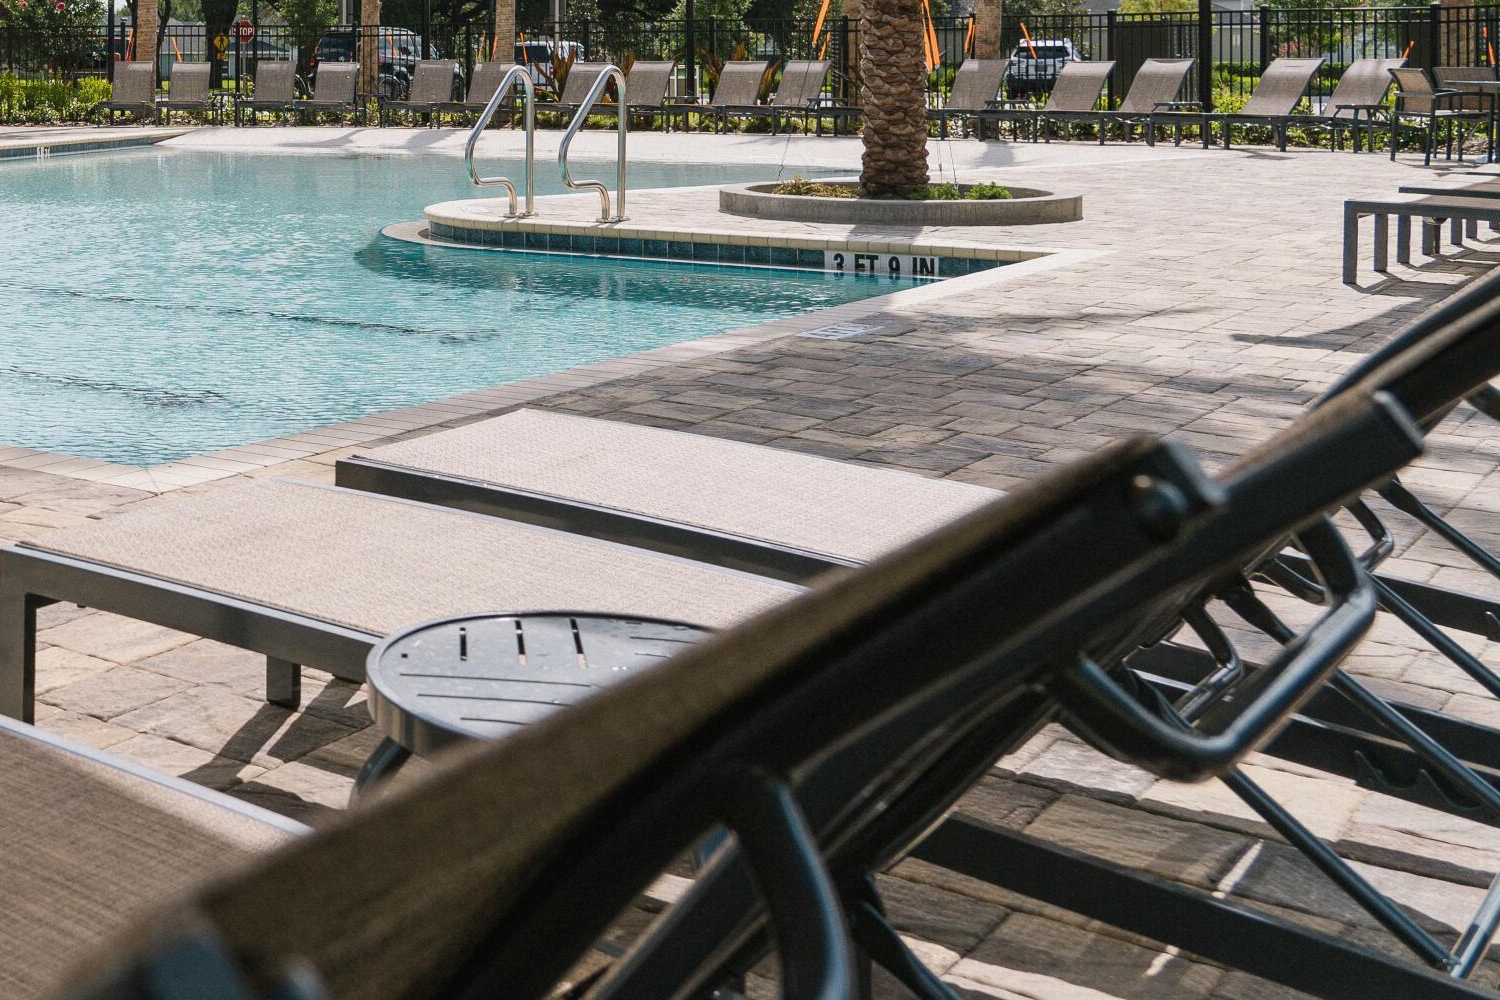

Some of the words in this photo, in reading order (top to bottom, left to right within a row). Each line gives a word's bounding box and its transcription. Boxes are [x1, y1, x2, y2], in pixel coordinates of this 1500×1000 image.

[833, 252, 845, 270] 3
[854, 253, 879, 272] FT
[888, 256, 900, 273] 9
[912, 256, 936, 275] IN
